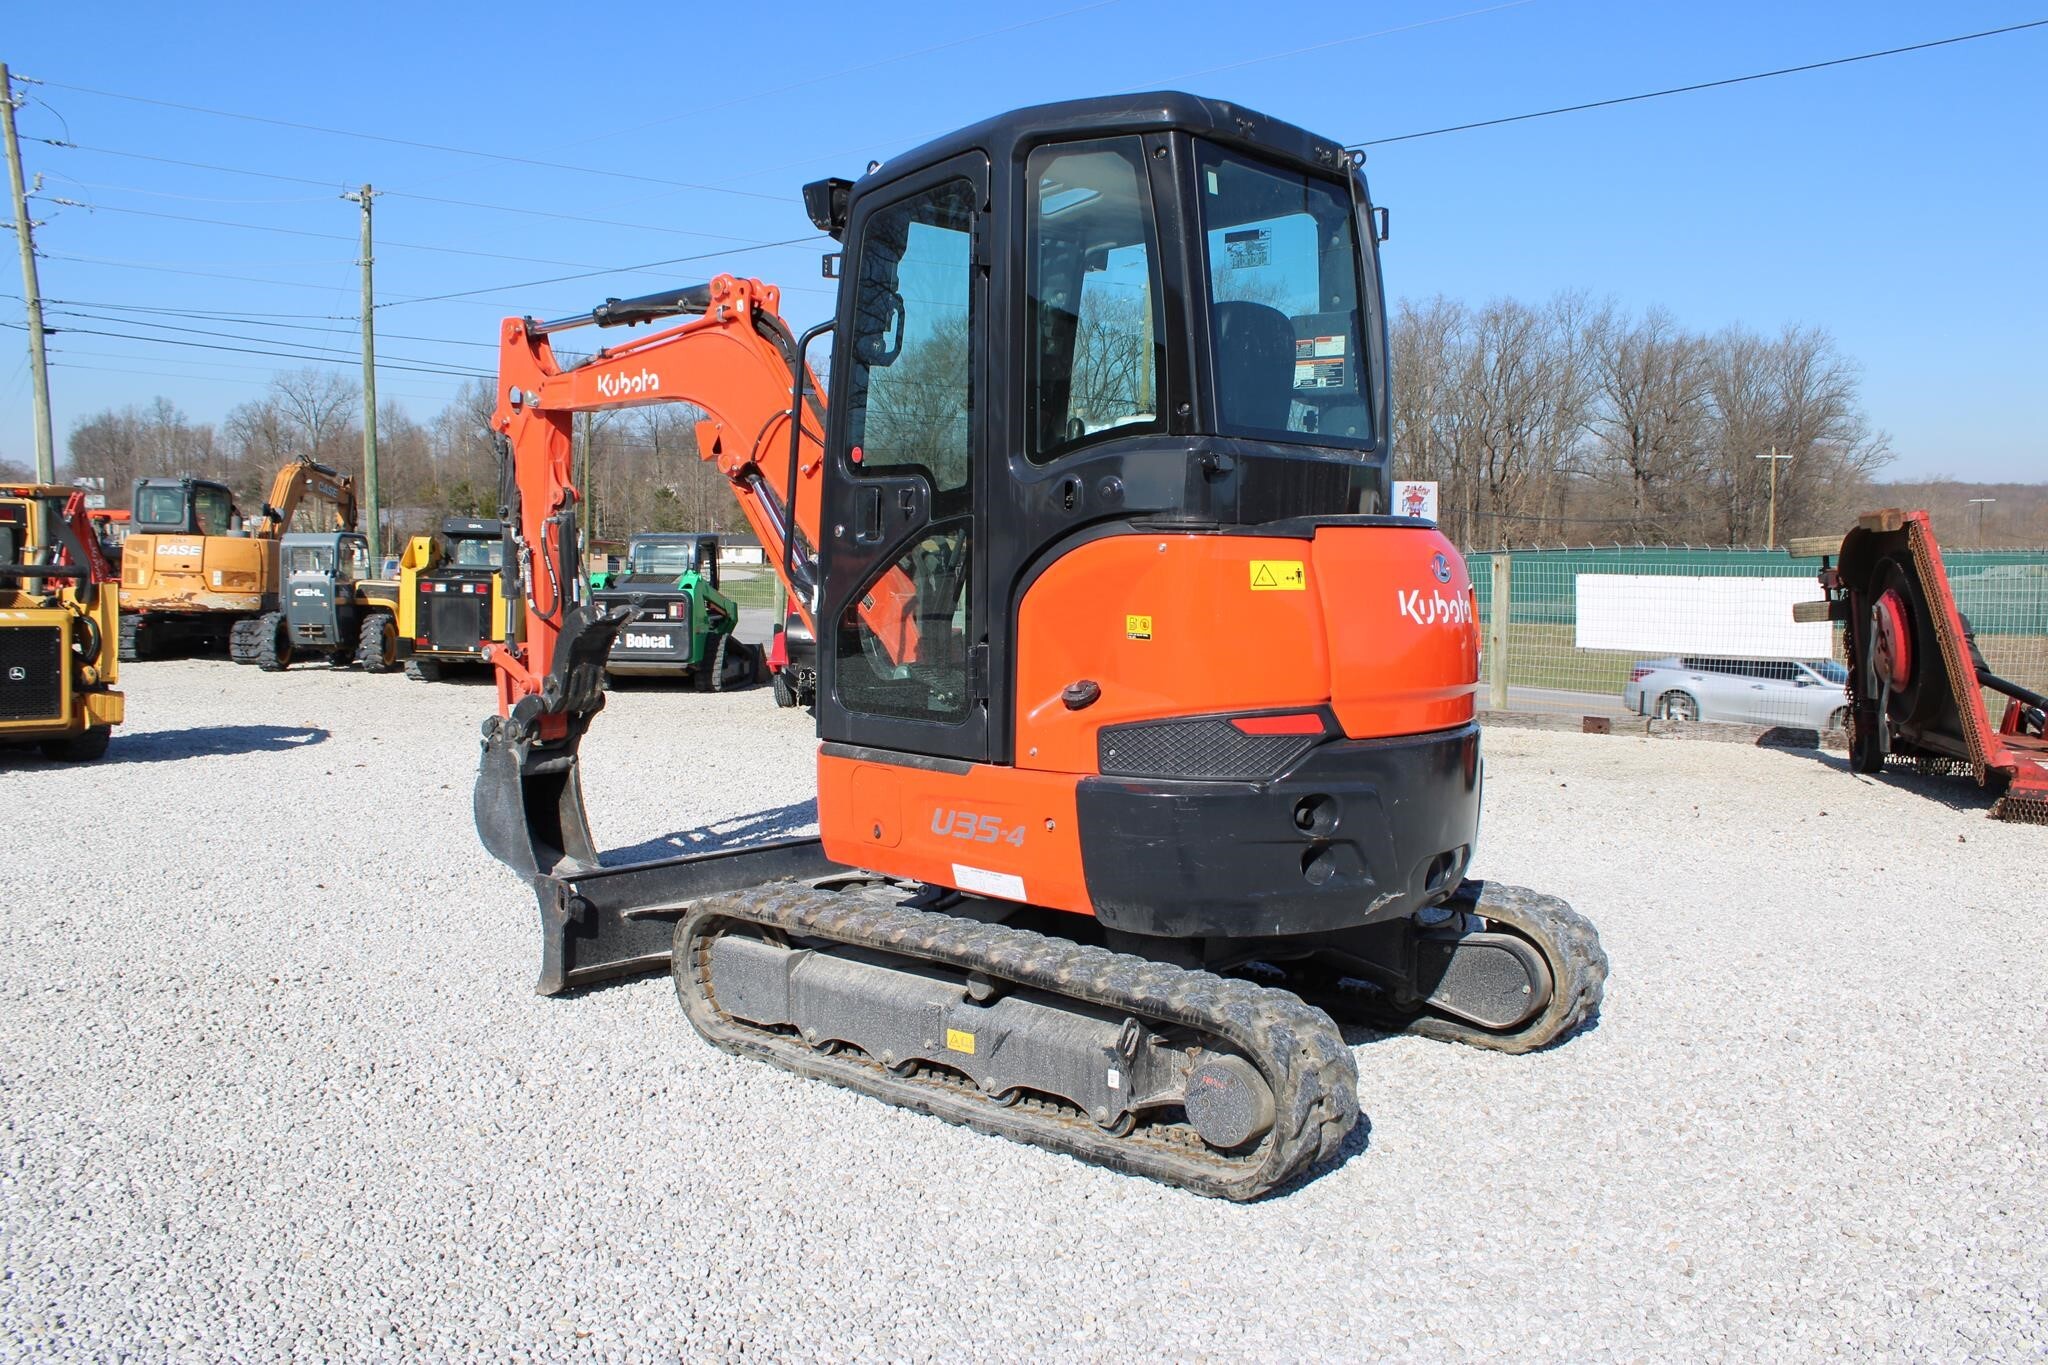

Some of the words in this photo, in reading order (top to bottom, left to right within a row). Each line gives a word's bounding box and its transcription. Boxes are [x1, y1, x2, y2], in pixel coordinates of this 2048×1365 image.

[597, 368, 659, 397] Kubota
[157, 544, 202, 556] CASE
[294, 588, 325, 597] GEHL
[1398, 589, 1473, 624] Kubota
[931, 807, 1026, 847] U35-4
